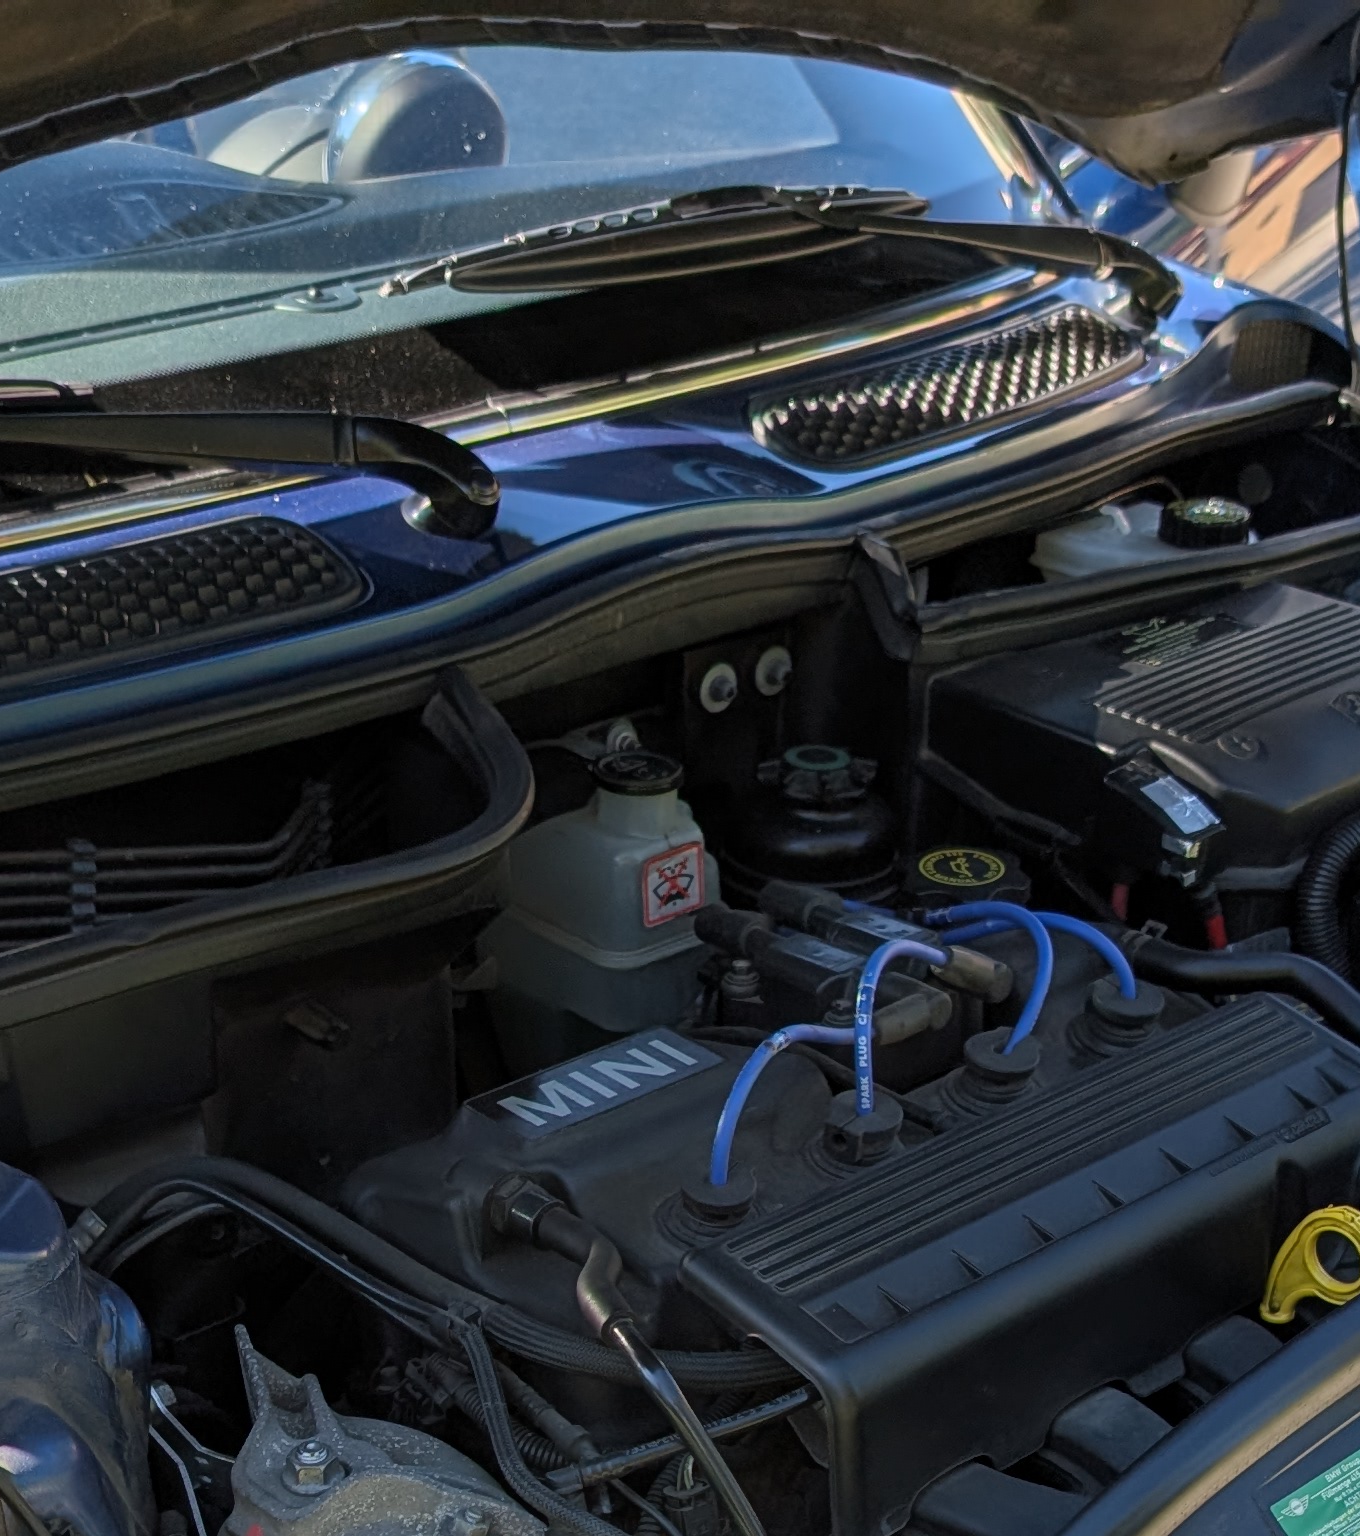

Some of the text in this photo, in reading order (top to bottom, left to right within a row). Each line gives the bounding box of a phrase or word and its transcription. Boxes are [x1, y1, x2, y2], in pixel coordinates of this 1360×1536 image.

[857, 1035, 869, 1067] PLUG
[496, 1039, 699, 1127] MINI
[859, 1076, 871, 1110] SPARK
[1324, 1455, 1360, 1482] BMW Group
